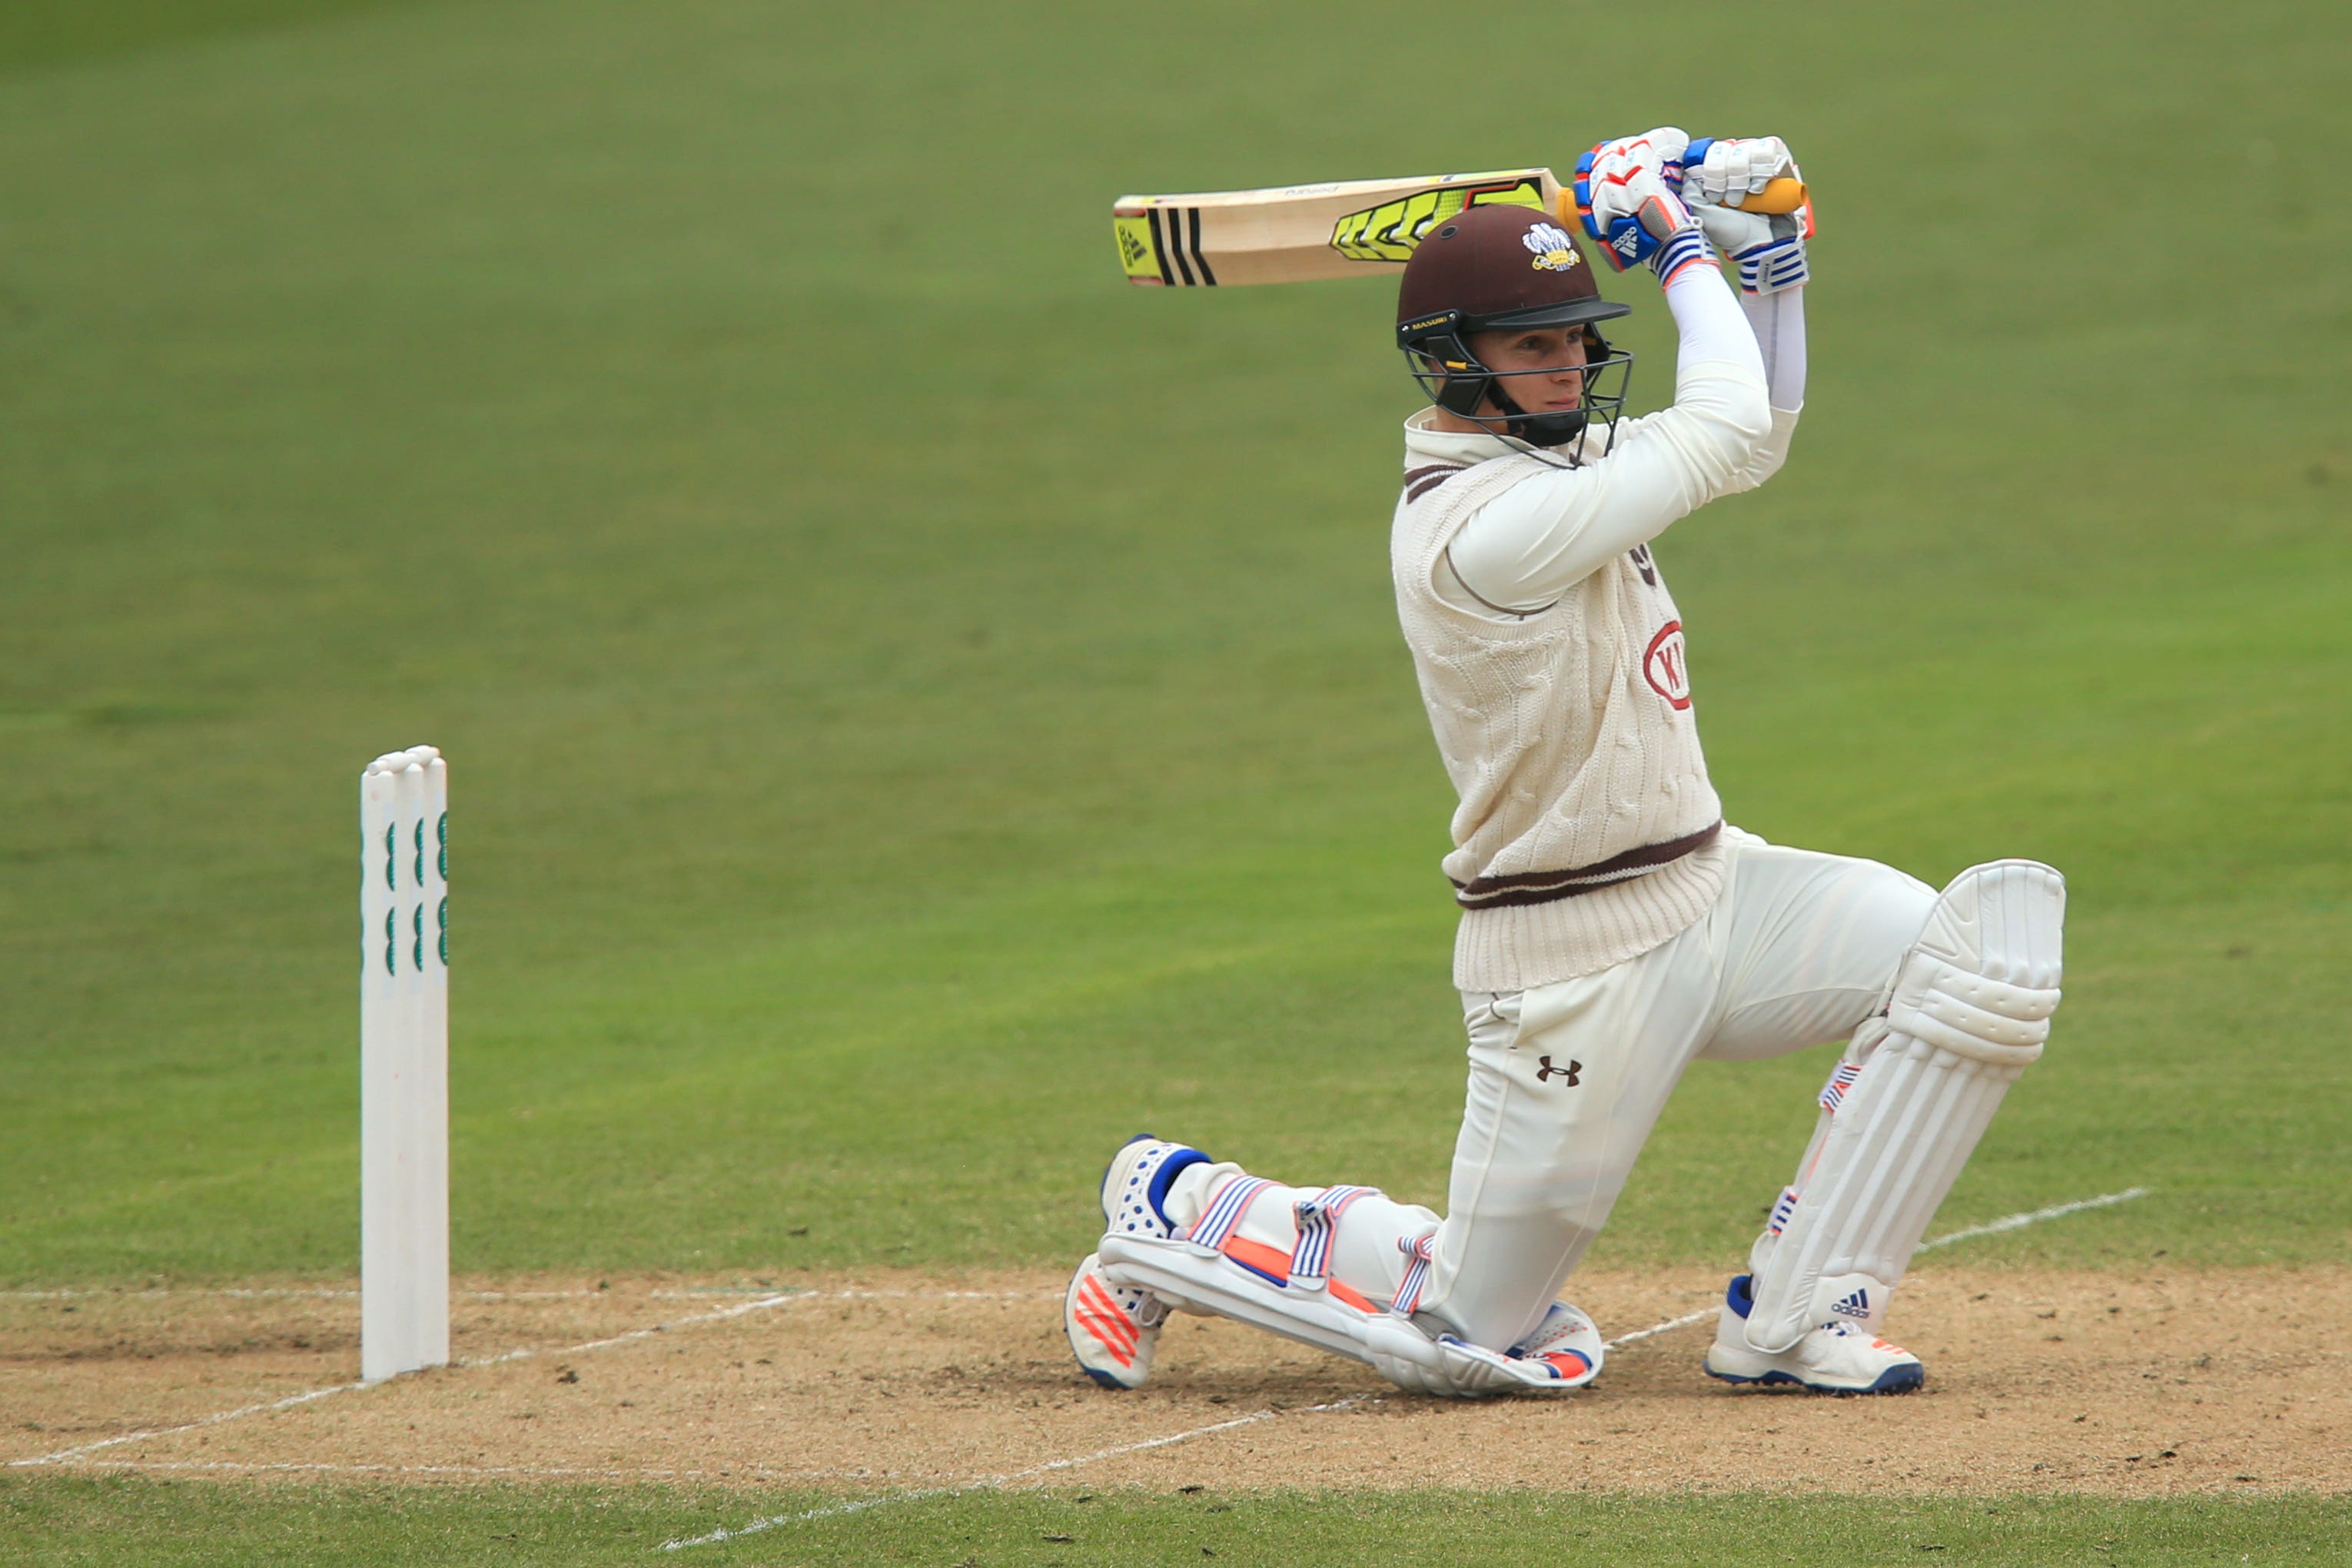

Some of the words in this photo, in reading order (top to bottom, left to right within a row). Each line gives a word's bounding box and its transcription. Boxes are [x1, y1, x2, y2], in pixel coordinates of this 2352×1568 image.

[1118, 226, 1133, 267] adidas
[1611, 226, 1637, 251] adidas
[1411, 316, 1447, 331] MASURI
[1656, 641, 1684, 693] KI
[1831, 1304, 1871, 1319] adidas
